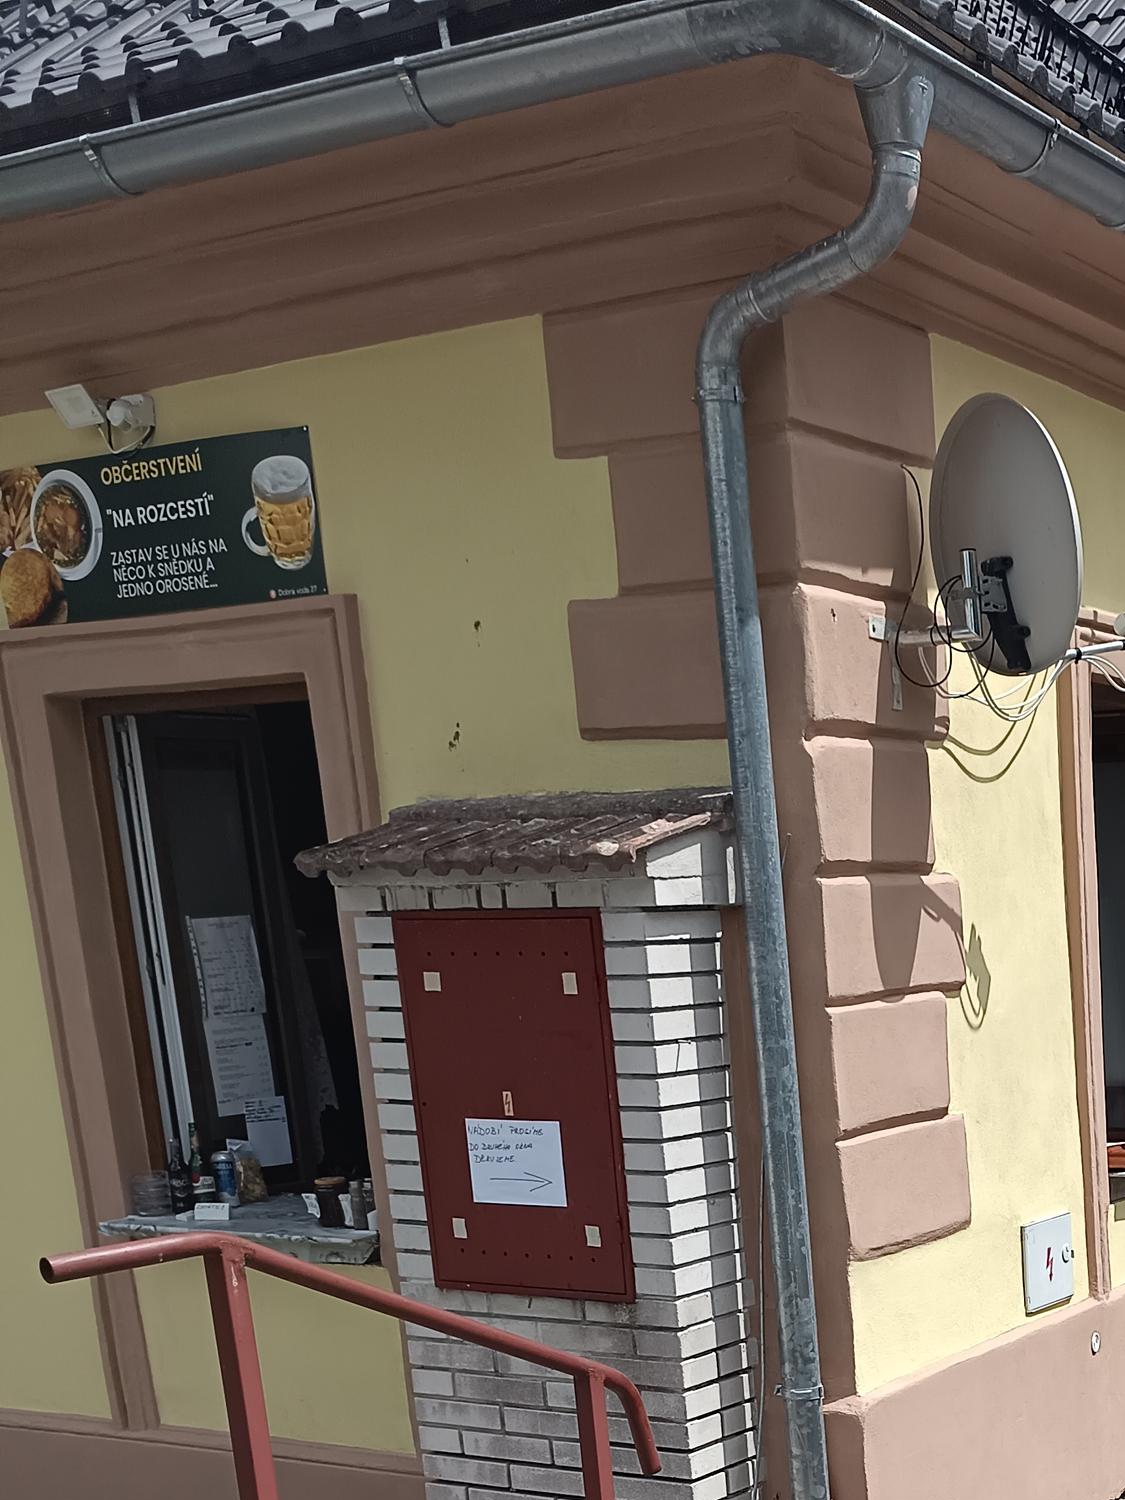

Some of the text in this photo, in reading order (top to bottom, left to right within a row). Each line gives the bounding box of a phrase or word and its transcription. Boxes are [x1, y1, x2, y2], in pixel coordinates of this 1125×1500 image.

[101, 447, 203, 486] OBČERSTVENÍ
[106, 491, 214, 528] "NA ROZCESTÍ"
[110, 538, 228, 566] ZASTAV SE U NÁS NA
[113, 556, 216, 582] NĚCO K SNĚDKU A
[116, 570, 218, 598] JEDNO OROSENÉ...
